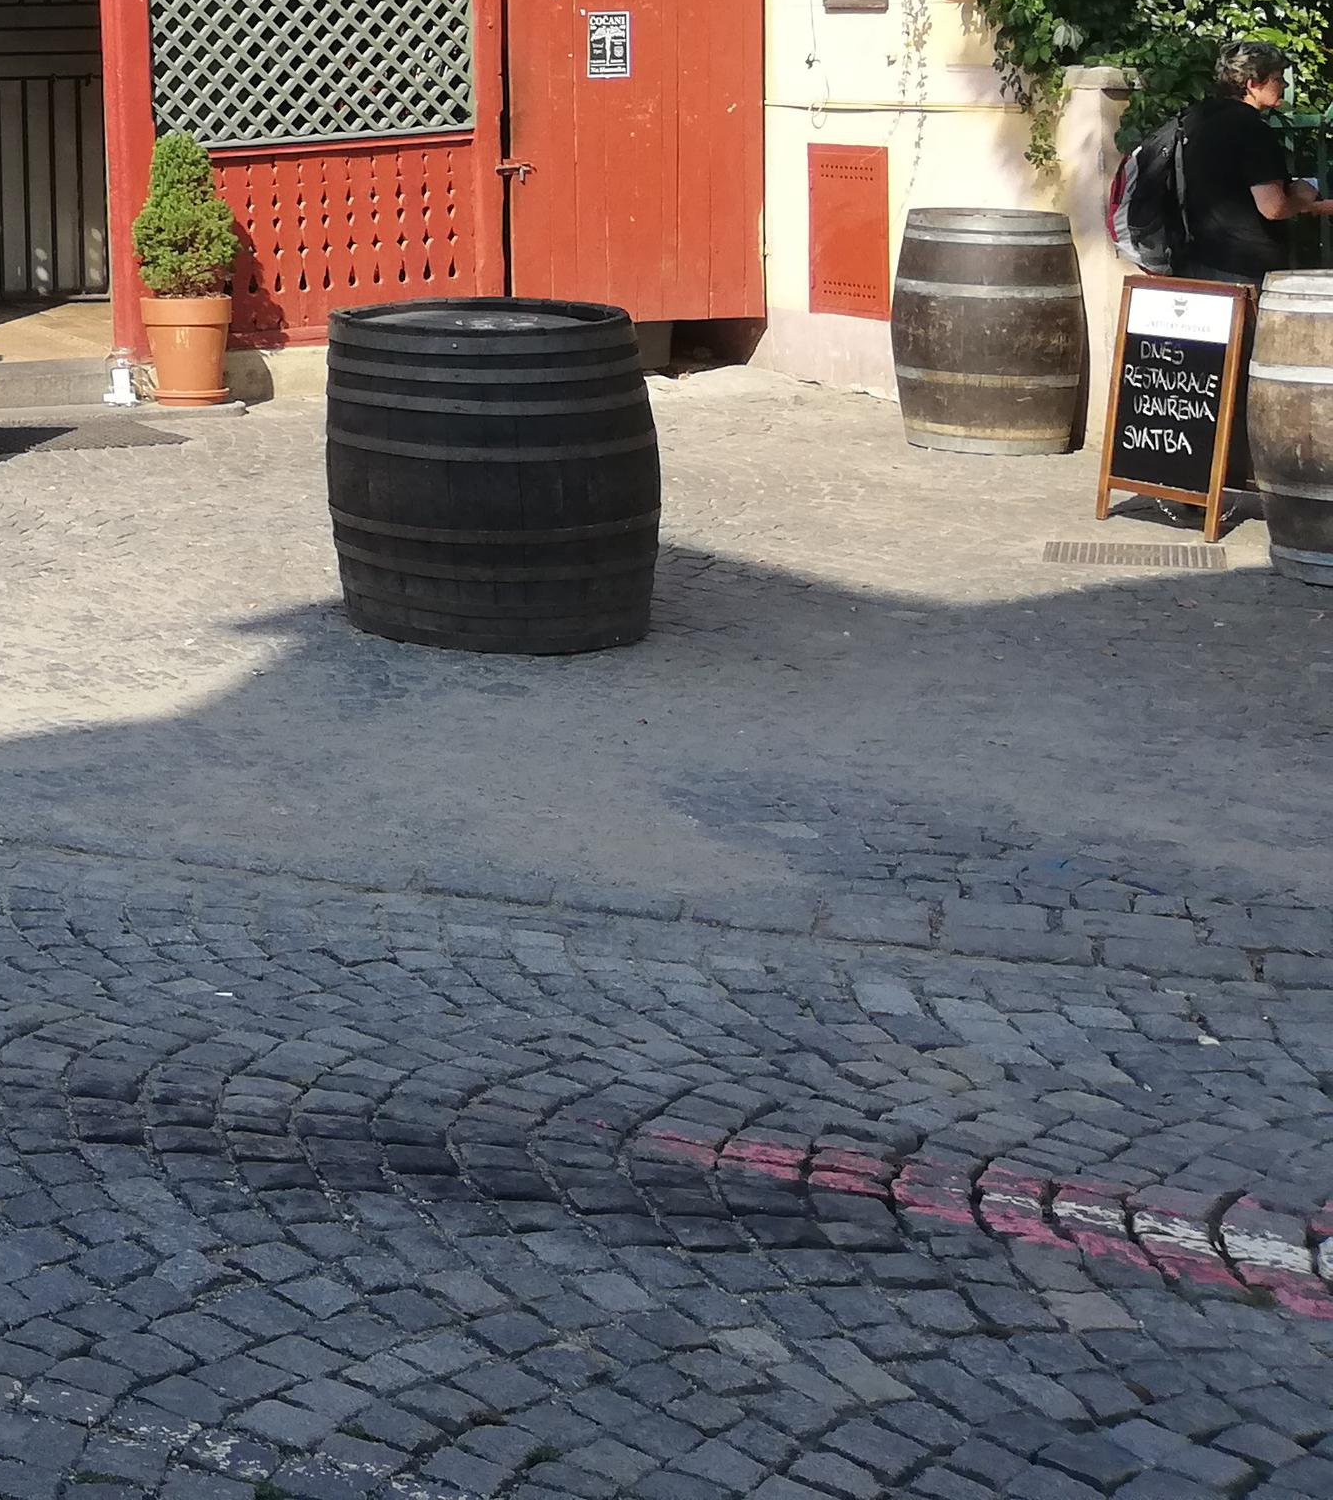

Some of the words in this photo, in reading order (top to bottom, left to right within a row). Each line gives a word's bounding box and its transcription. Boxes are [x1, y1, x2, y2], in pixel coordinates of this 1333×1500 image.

[1139, 340, 1184, 365] DNES
[1123, 363, 1219, 398] RESTAURACE
[1133, 394, 1216, 422] UZAVŘENA
[1121, 424, 1193, 455] SVATBA
